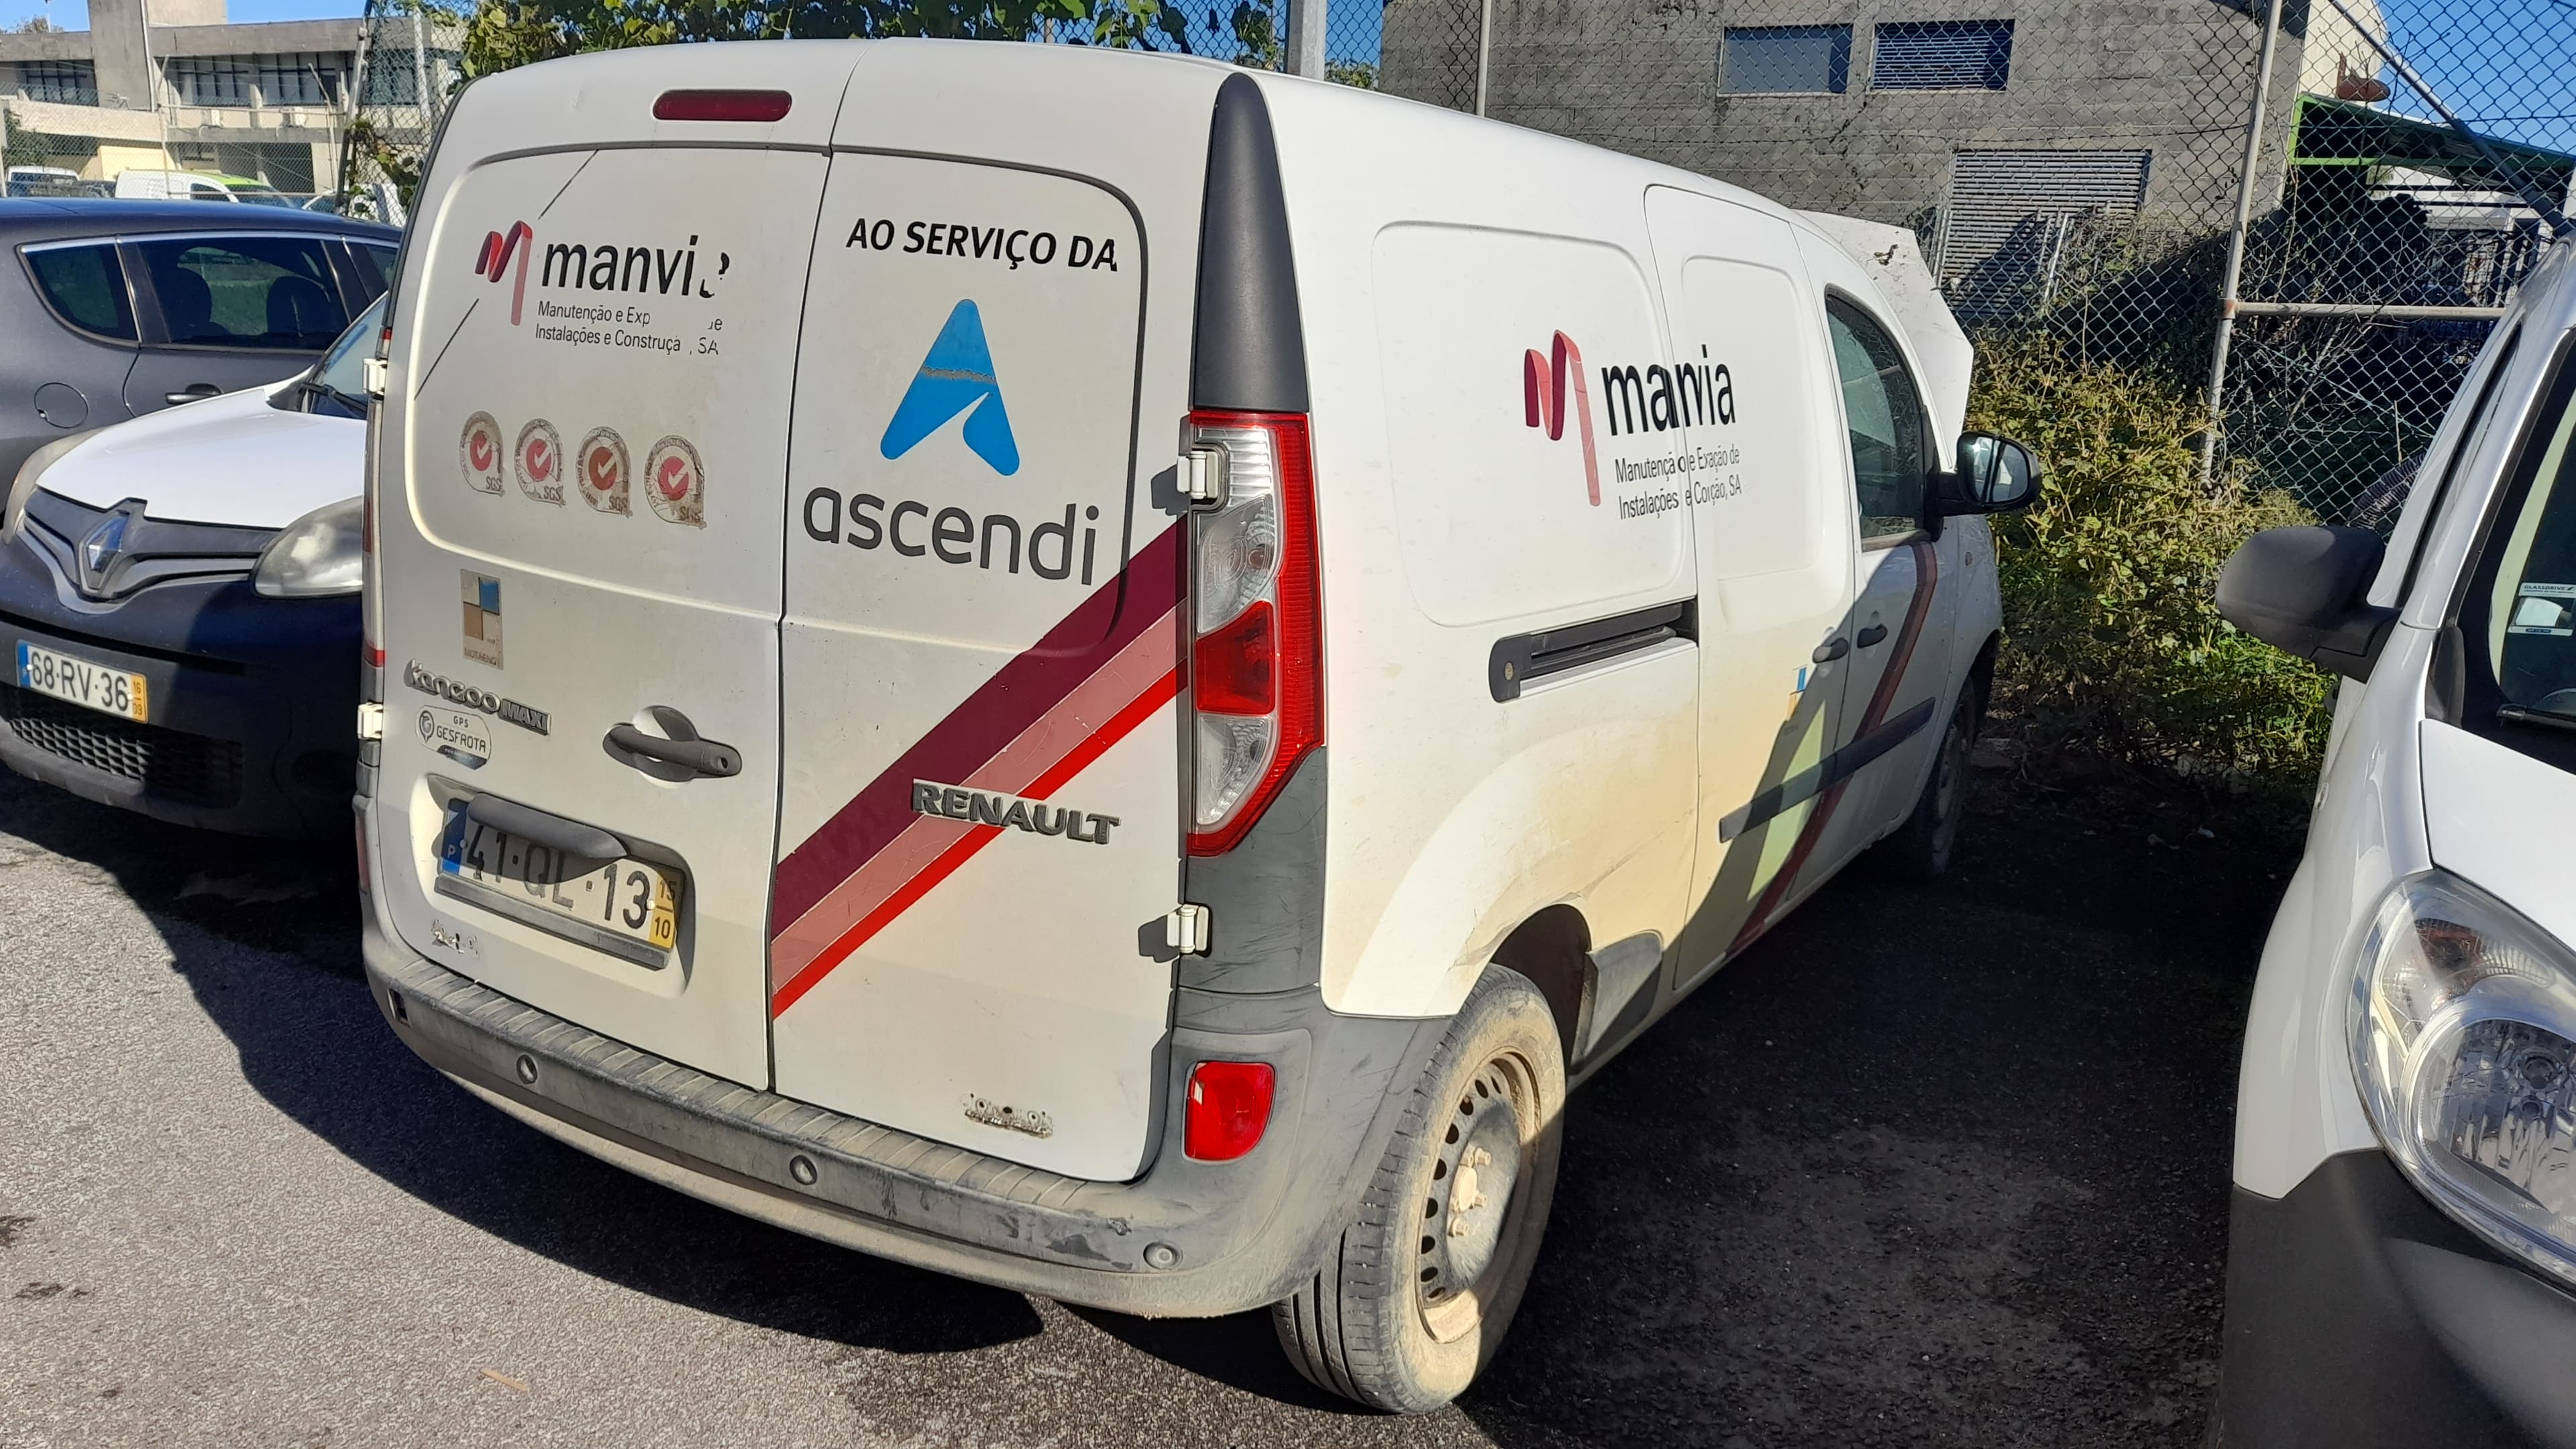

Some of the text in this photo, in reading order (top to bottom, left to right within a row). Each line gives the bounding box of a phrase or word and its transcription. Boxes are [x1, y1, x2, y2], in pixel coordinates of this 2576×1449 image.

[846, 218, 1118, 272] AO SERVIÇO DA
[538, 301, 612, 324] Manutenção
[615, 311, 623, 322] e
[535, 323, 600, 345] Instalações
[604, 332, 611, 345] e
[1729, 443, 1740, 464] de
[486, 476, 502, 491] SGS
[544, 486, 561, 500] SGS
[1619, 488, 1679, 519] Instalações
[1729, 474, 1742, 496] SA
[804, 486, 1099, 586] ascendi
[453, 716, 468, 728] GPS
[437, 725, 486, 753] GESFROTA
[913, 782, 1121, 845] RENAULT
[654, 916, 671, 939] 10
